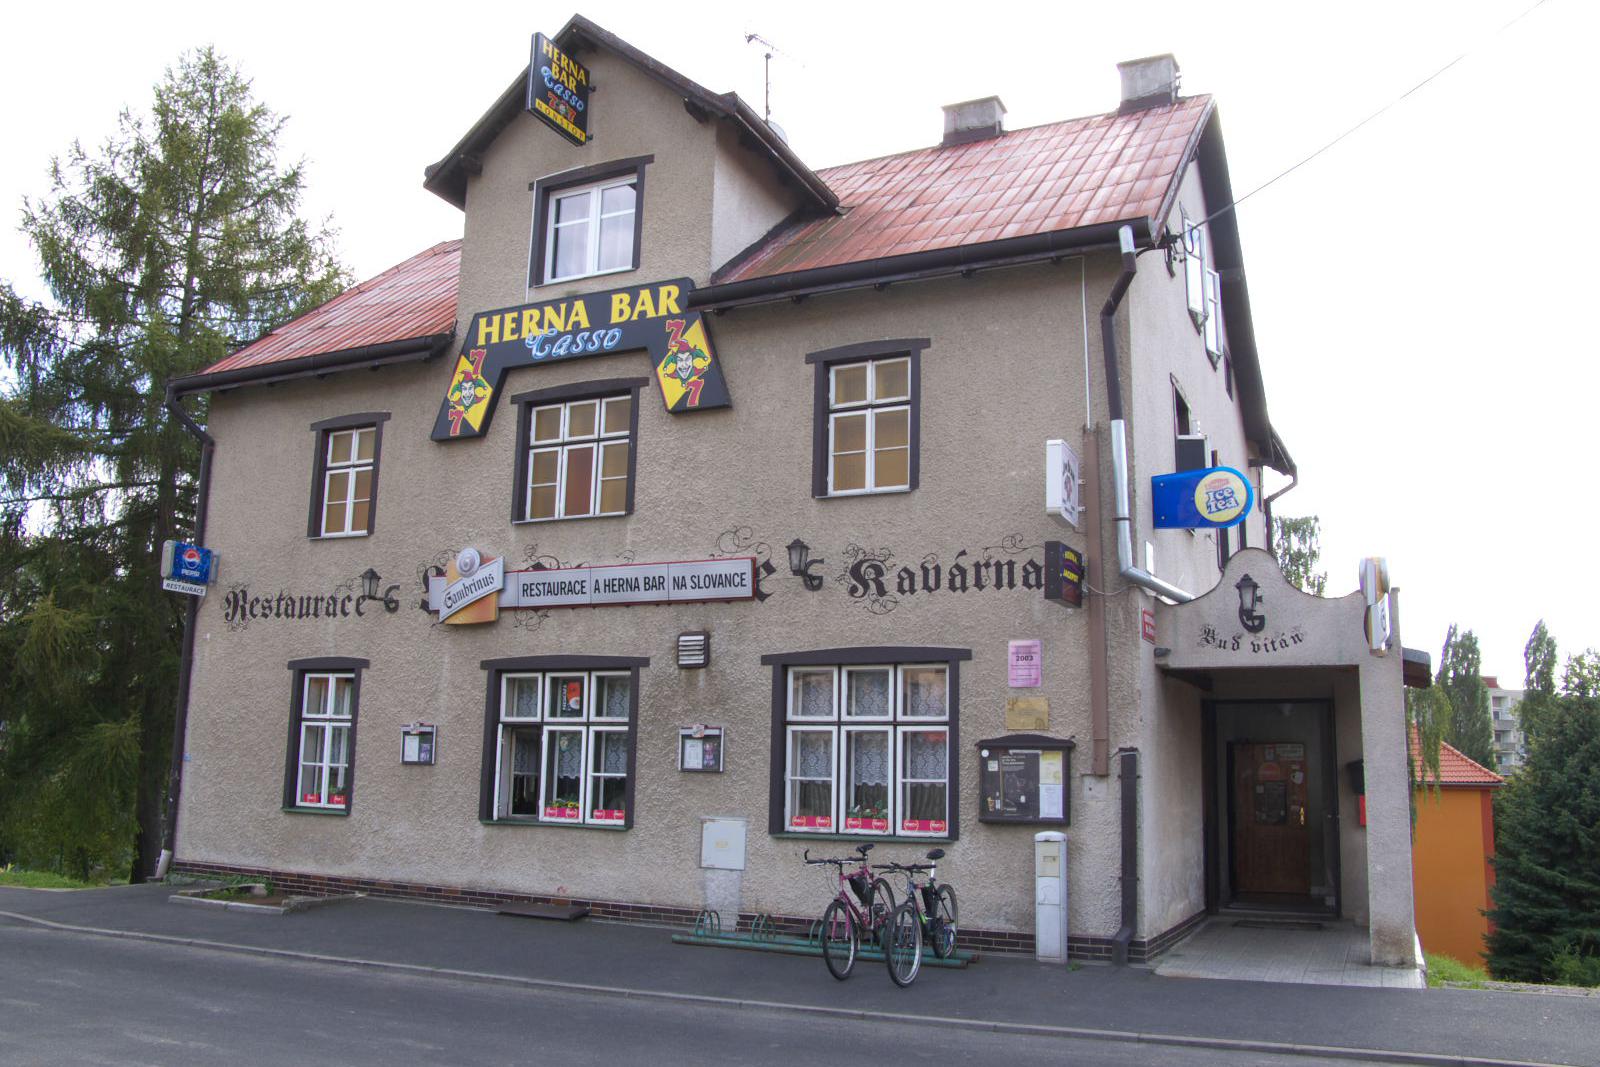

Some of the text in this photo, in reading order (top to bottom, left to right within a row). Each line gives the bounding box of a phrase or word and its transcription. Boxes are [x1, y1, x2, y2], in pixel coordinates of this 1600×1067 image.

[543, 38, 587, 86] HERNA
[551, 61, 577, 94] BAR
[477, 285, 681, 346] HERNA BAR
[665, 319, 686, 349] 7
[469, 349, 486, 376] 7
[685, 379, 705, 407] 7
[448, 409, 464, 436] 7
[1206, 487, 1234, 501] Ice
[1206, 497, 1239, 514] Tea
[165, 583, 204, 595] RESTAURACE
[224, 549, 1045, 622] Restaurace Kavárna
[444, 573, 495, 609] Gambrinus
[522, 572, 747, 598] RESTAURACE A HERNA BAR NA SLOVANCE
